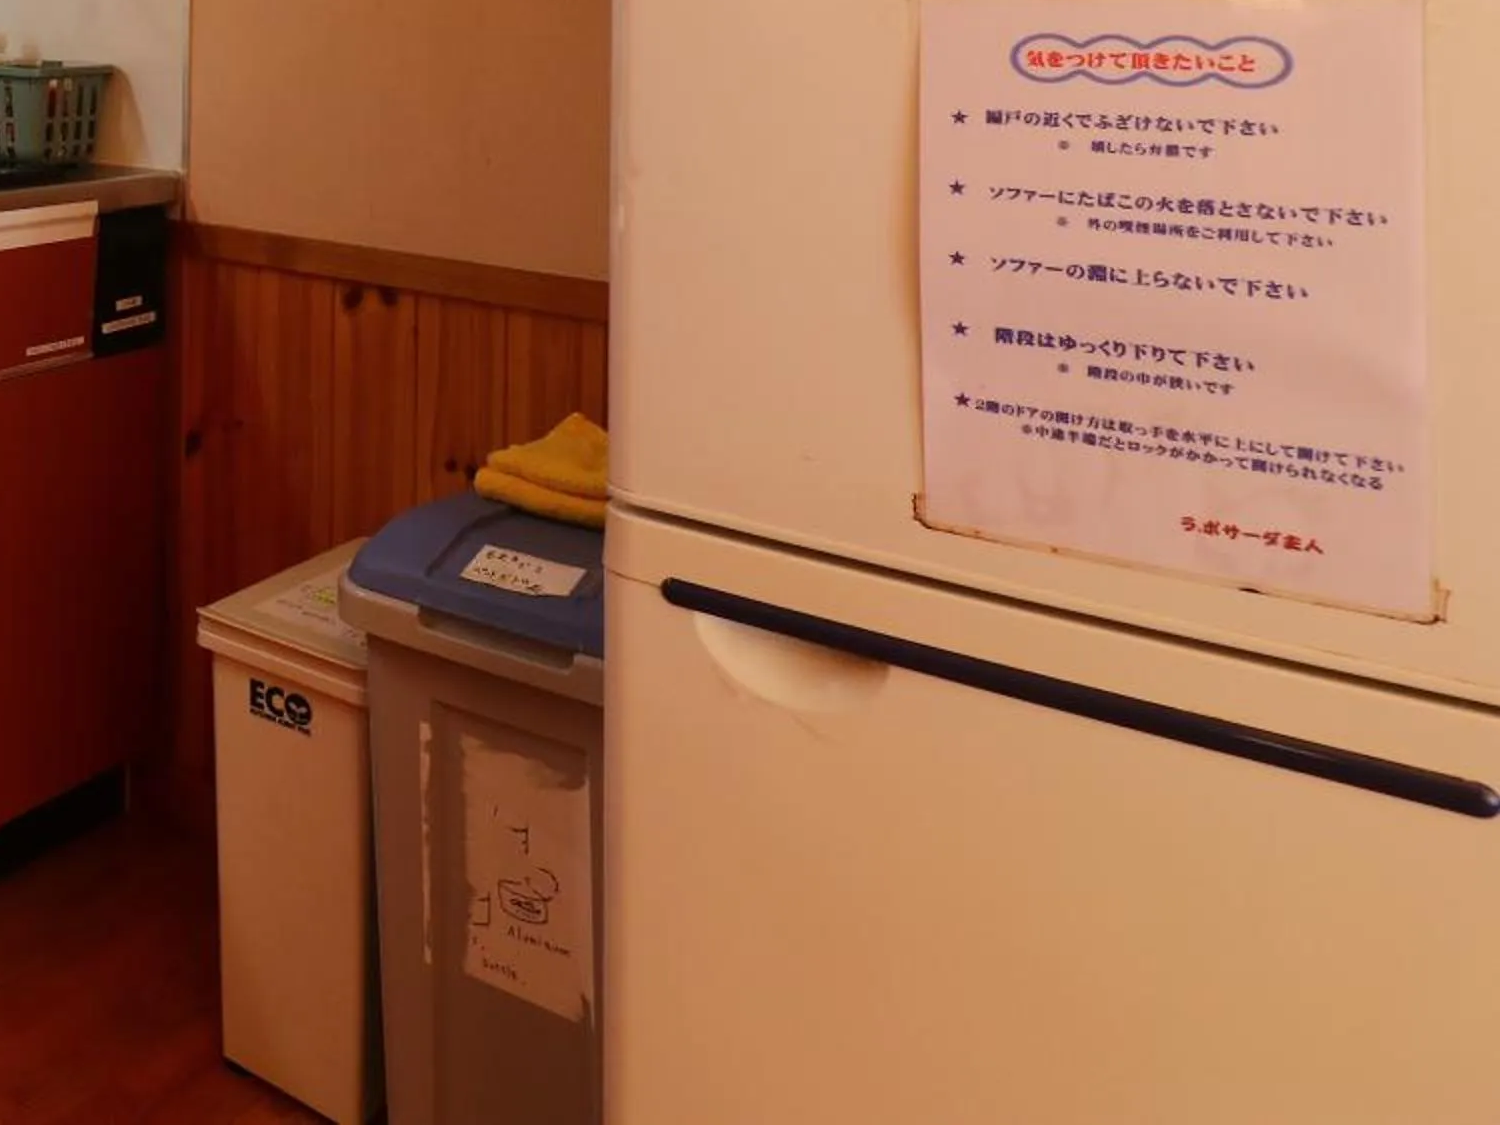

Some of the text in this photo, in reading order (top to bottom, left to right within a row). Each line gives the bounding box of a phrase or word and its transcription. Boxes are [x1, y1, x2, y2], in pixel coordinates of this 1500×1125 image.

[1026, 50, 1256, 74] 気をつけて頂きたいこと
[988, 185, 1389, 227] ソファーにたばこの火を落とさないで下さい
[993, 326, 1256, 373] 階段はゆっくり下りて下さい
[249, 678, 313, 727] ECO
